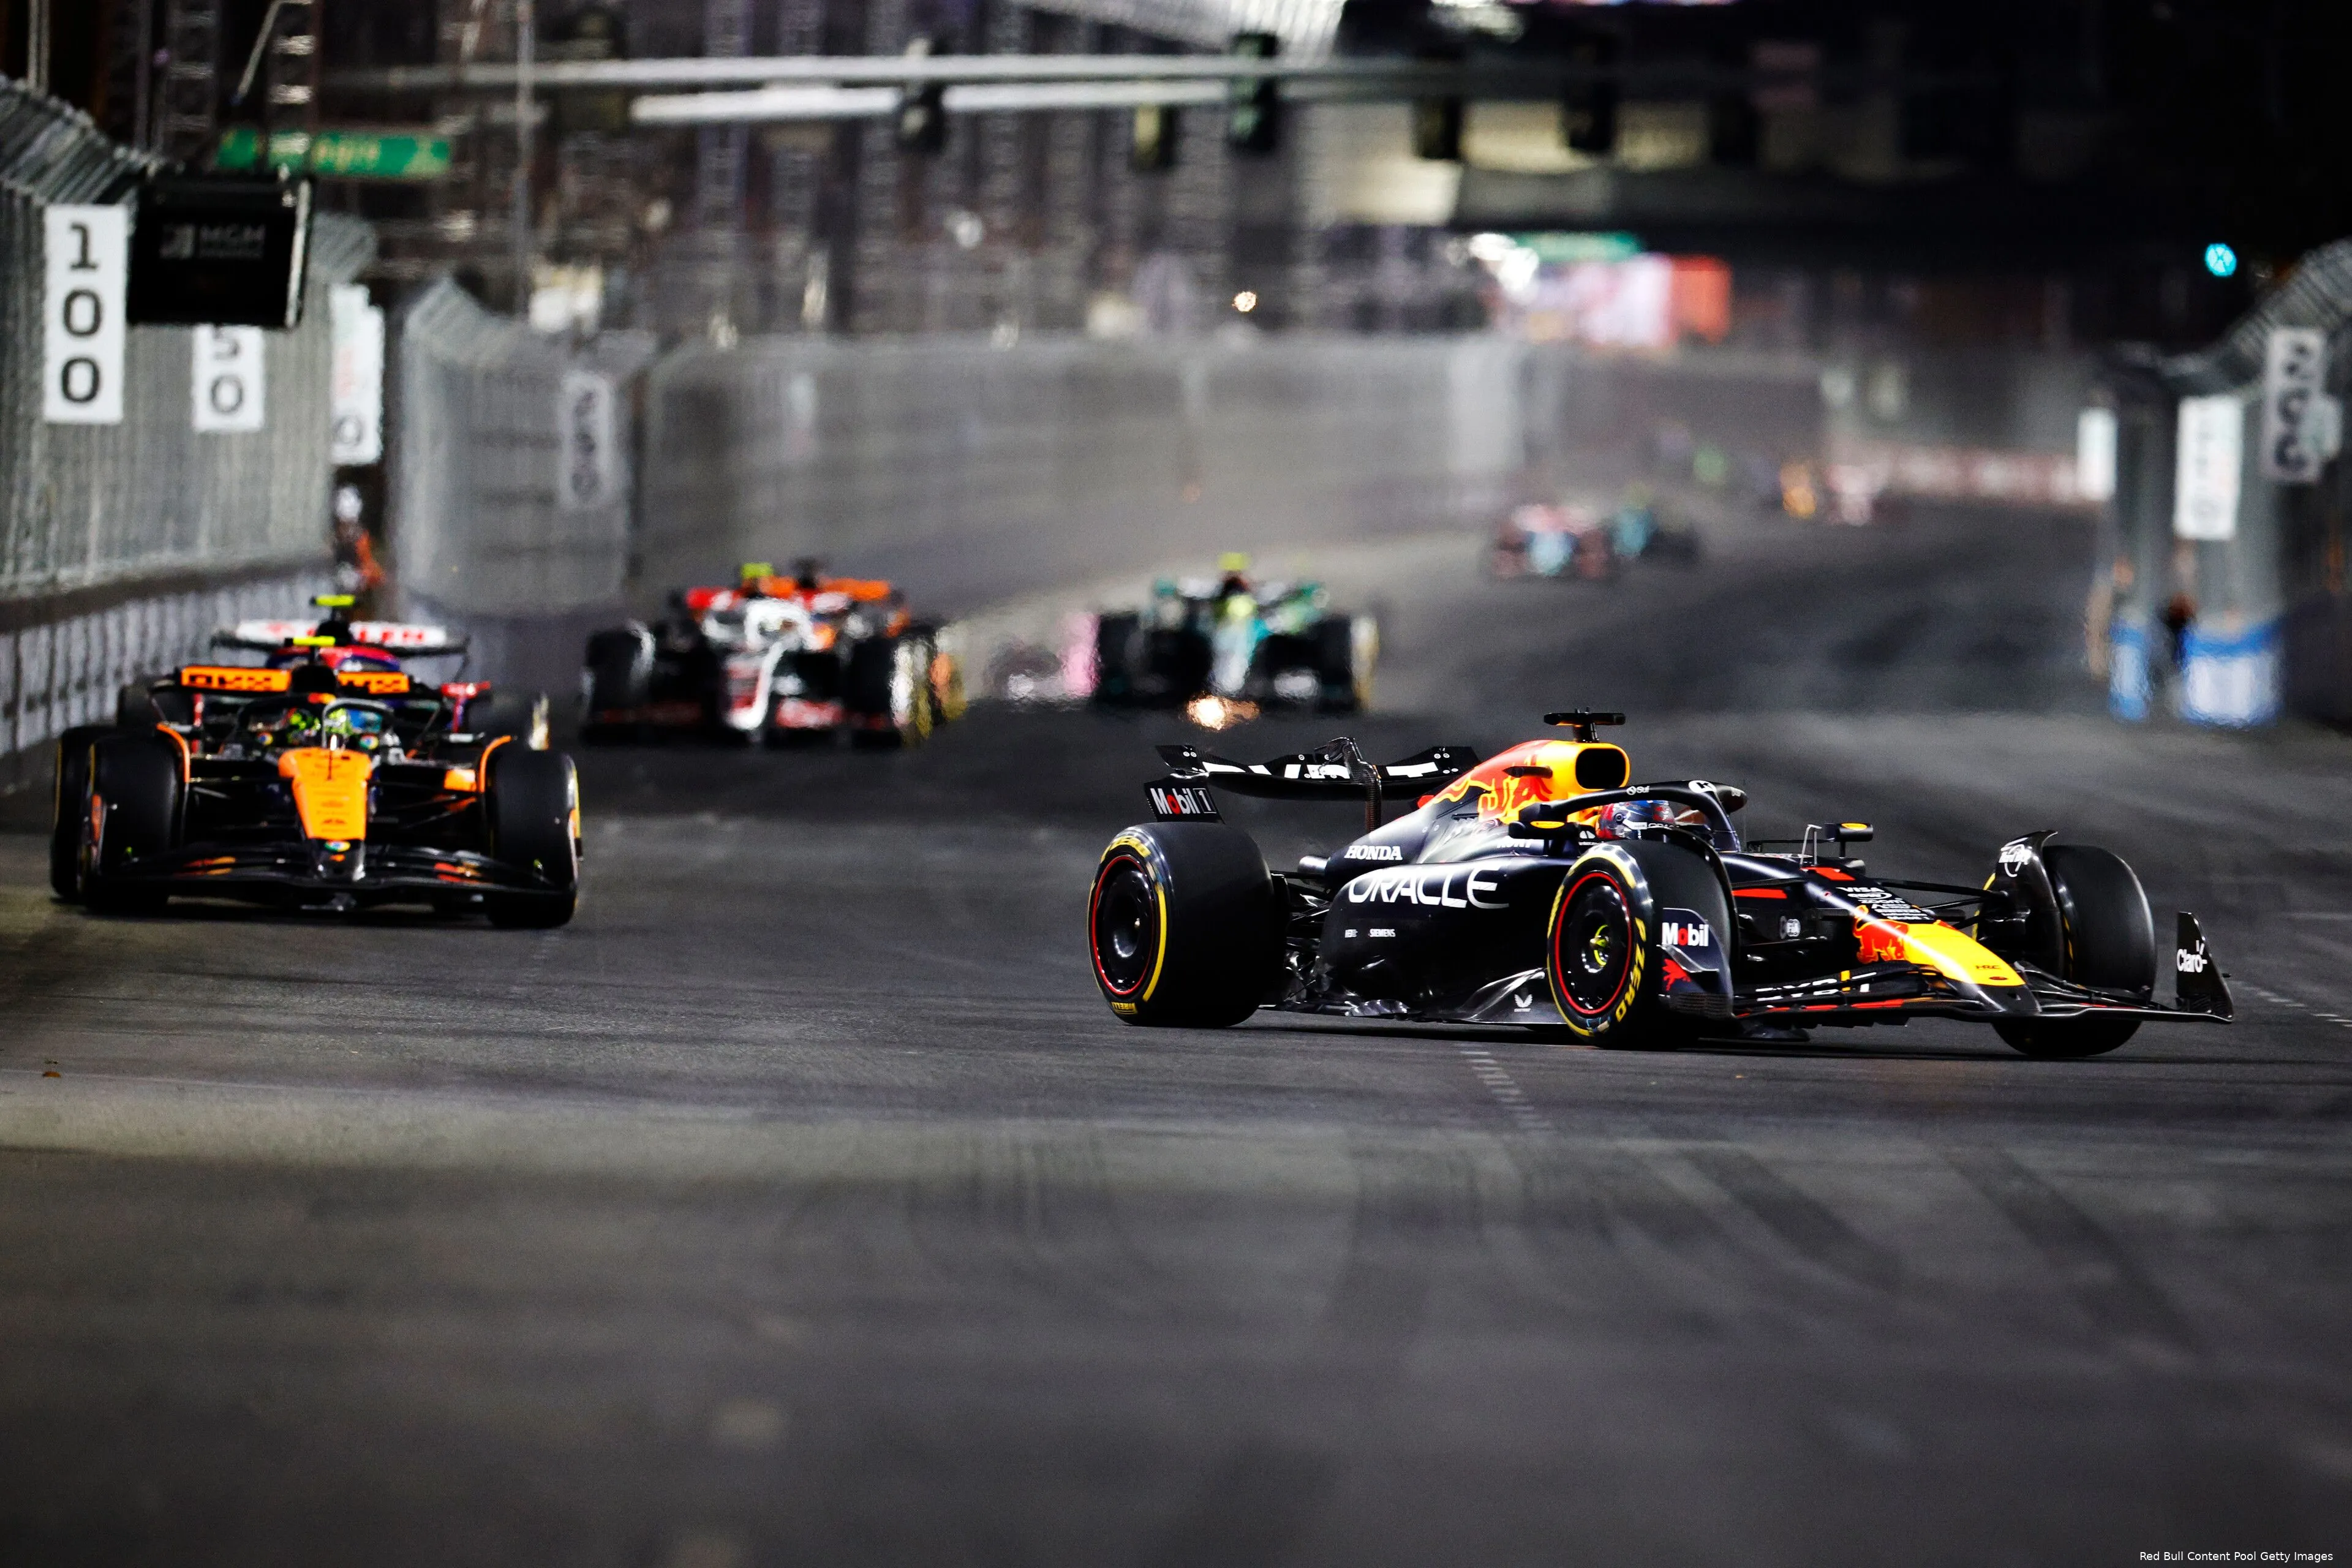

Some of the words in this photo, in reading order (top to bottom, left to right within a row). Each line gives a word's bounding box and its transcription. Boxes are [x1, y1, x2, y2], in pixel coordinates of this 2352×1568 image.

[61, 223, 102, 402] 100
[1150, 788, 1200, 814] Mobil
[1197, 789, 1214, 813] 1
[1344, 845, 1403, 861] HONDA
[1348, 865, 1510, 910] ORACLE
[1370, 929, 1396, 938] SIEMENS
[1662, 922, 1709, 947] Mobil
[2177, 948, 2204, 973] Claro
[1615, 943, 1646, 1022] ZERO
